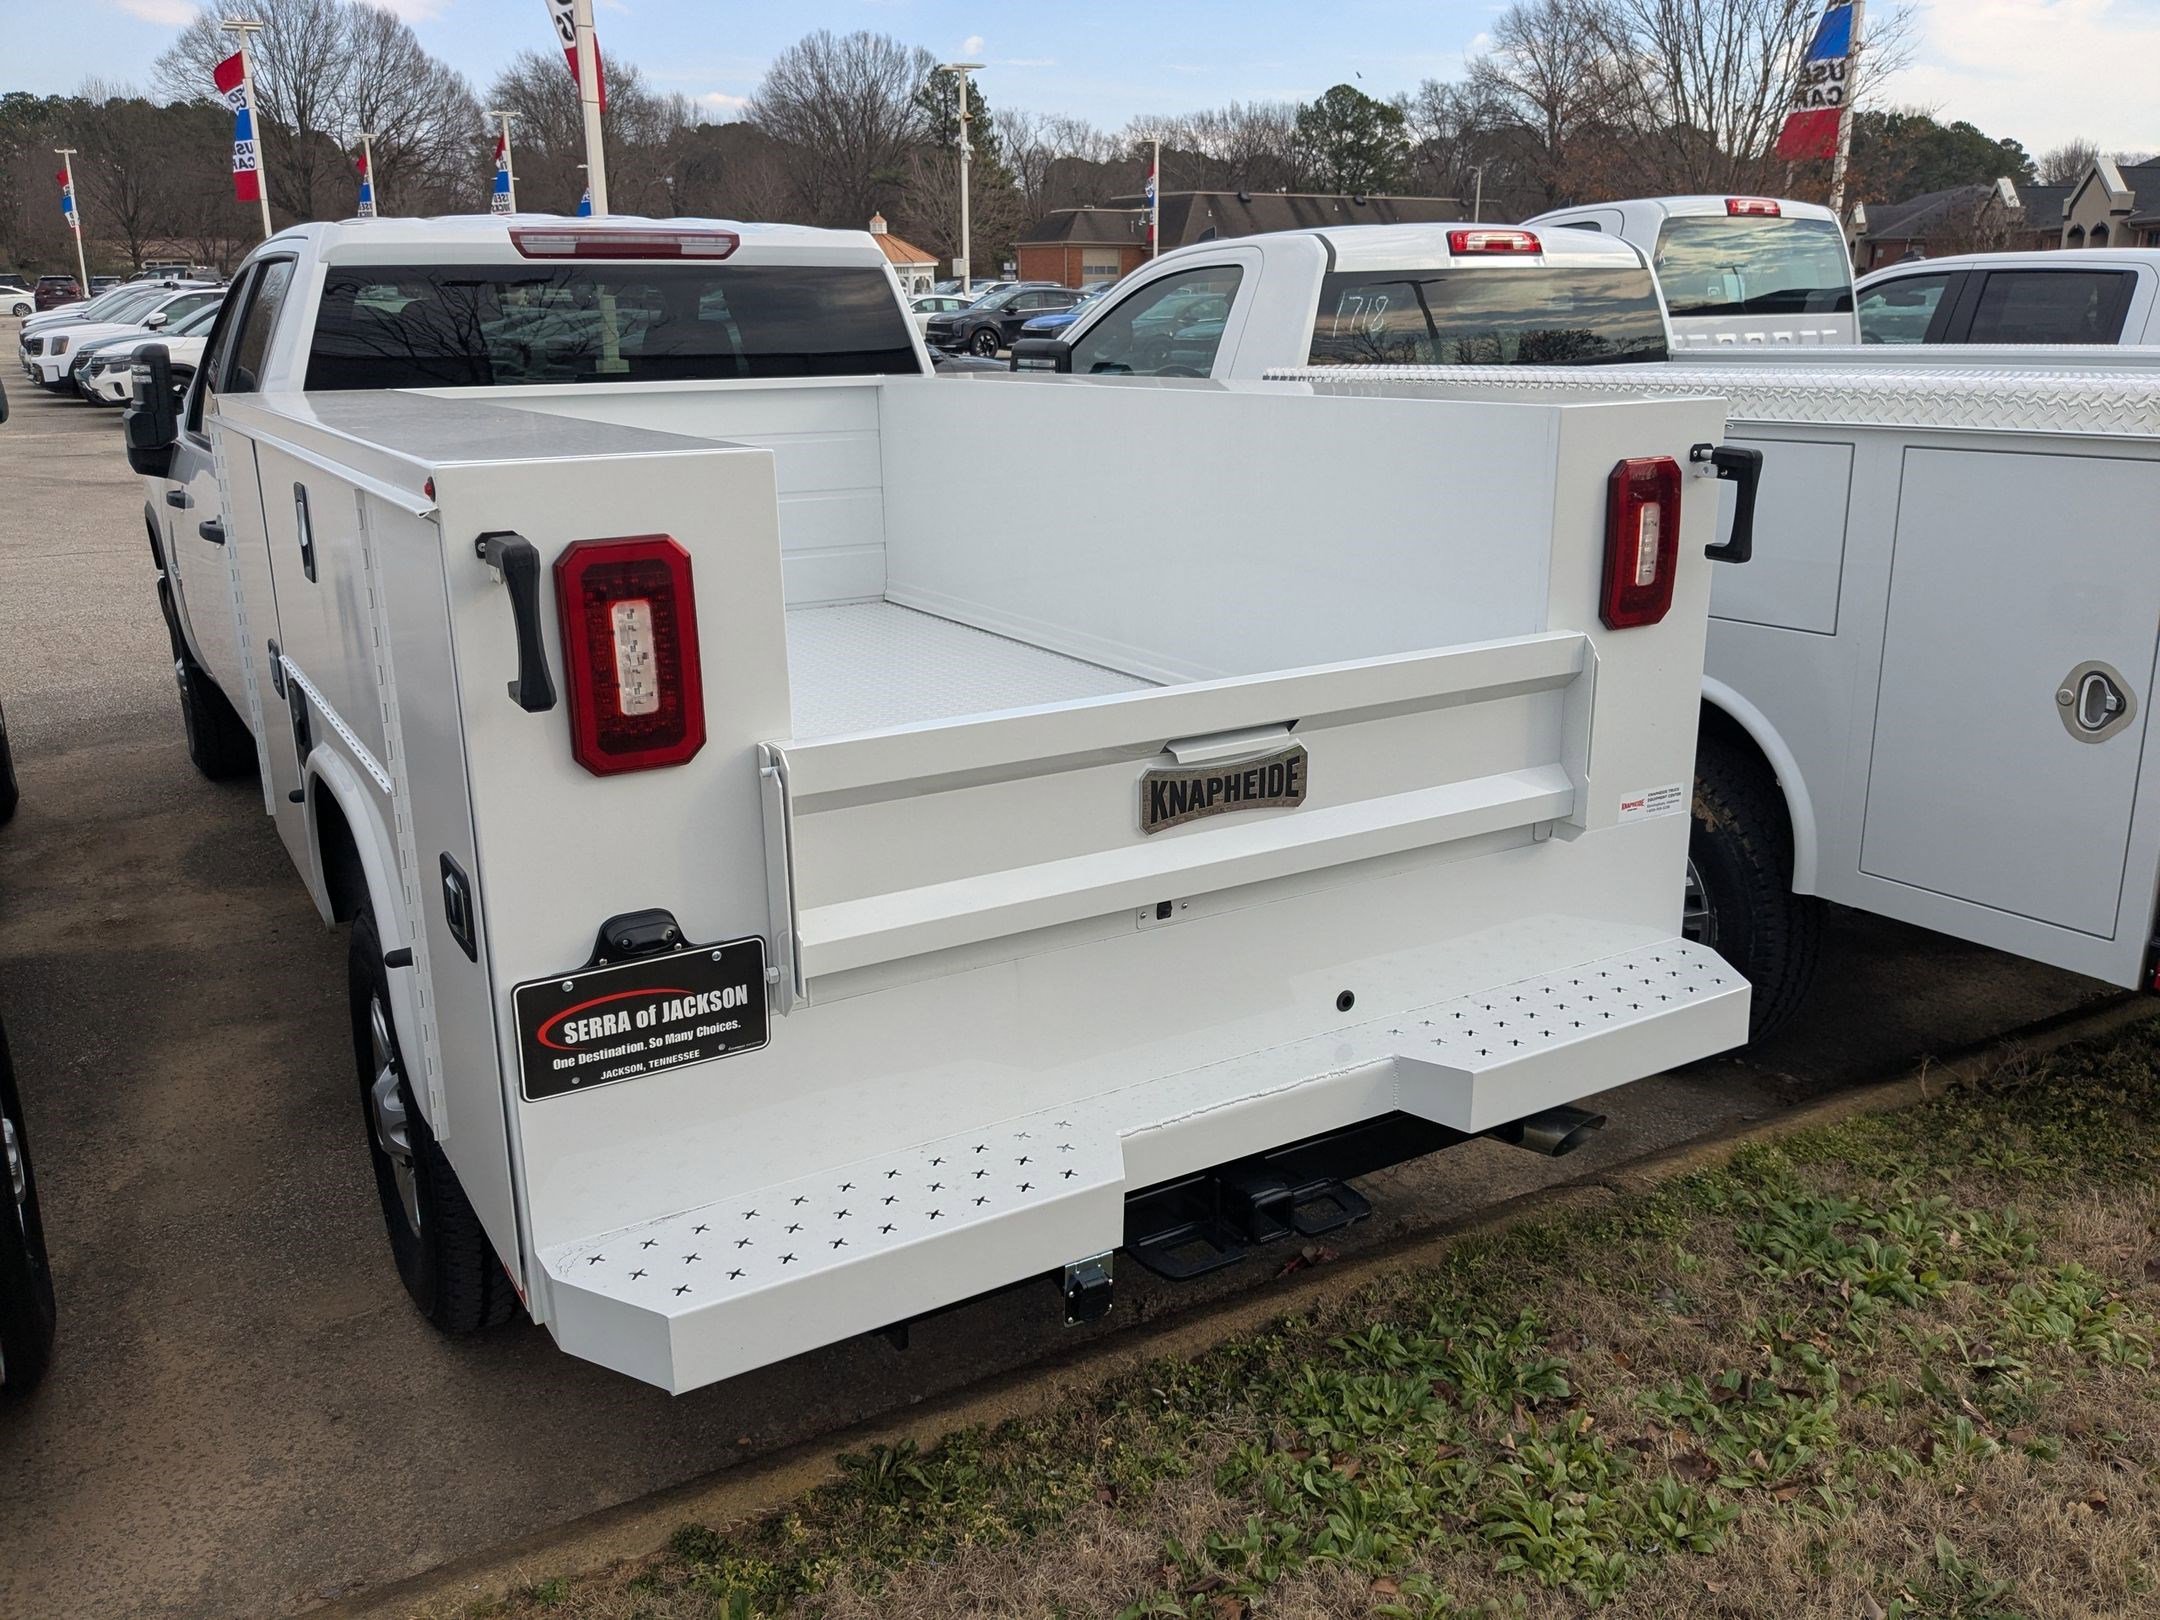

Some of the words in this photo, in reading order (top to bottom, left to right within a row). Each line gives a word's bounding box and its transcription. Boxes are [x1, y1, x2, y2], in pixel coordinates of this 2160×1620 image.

[1333, 291, 1389, 338] 1718
[1150, 755, 1300, 824] KNAPHEIDE
[563, 1010, 632, 1044] SERRA
[635, 1005, 656, 1029] of
[662, 984, 748, 1023] JACKSON
[552, 1056, 576, 1070] One
[578, 1042, 648, 1065] Destination.
[649, 1035, 663, 1049] So
[665, 1029, 694, 1046] Many
[696, 1019, 742, 1037] Choices.
[600, 1063, 647, 1080] JACKSON,
[649, 1049, 700, 1068] TENNESSEE
